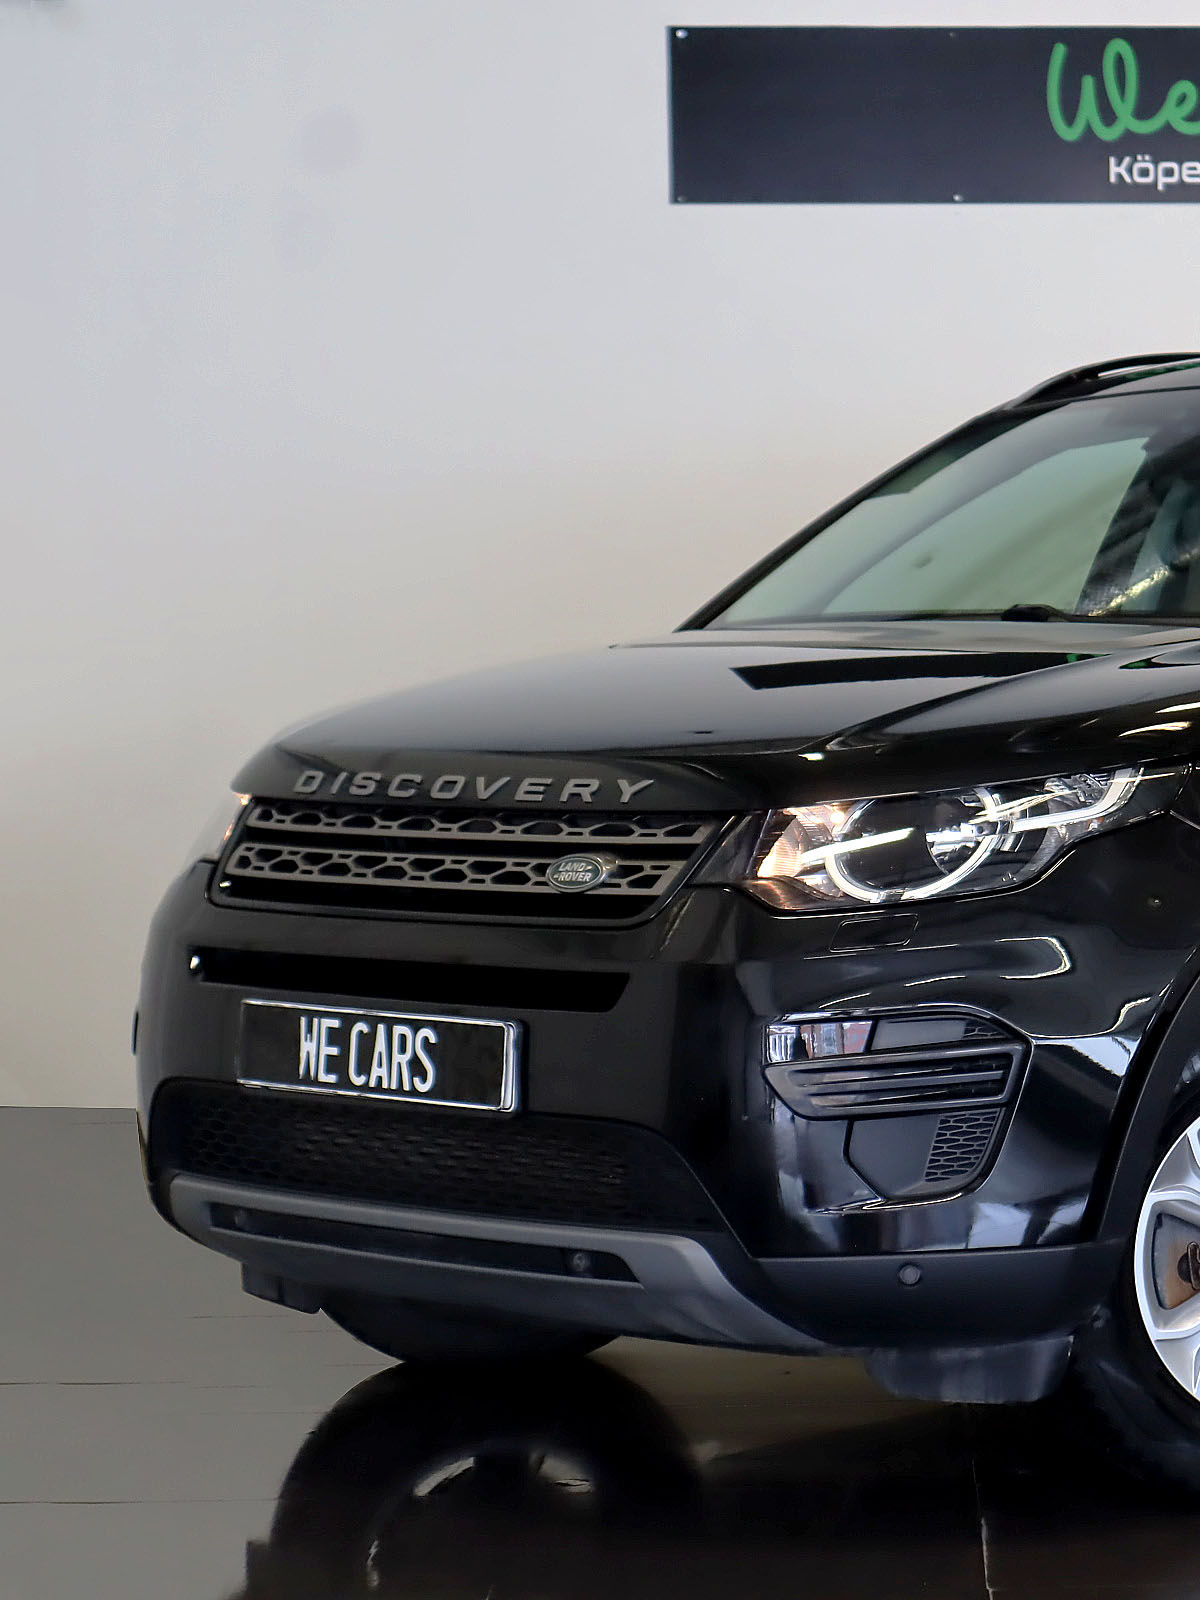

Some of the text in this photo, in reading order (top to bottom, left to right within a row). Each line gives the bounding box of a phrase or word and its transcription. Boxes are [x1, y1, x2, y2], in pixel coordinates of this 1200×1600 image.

[293, 769, 654, 804] DISCOVERY
[299, 1016, 438, 1093] WE CARS
